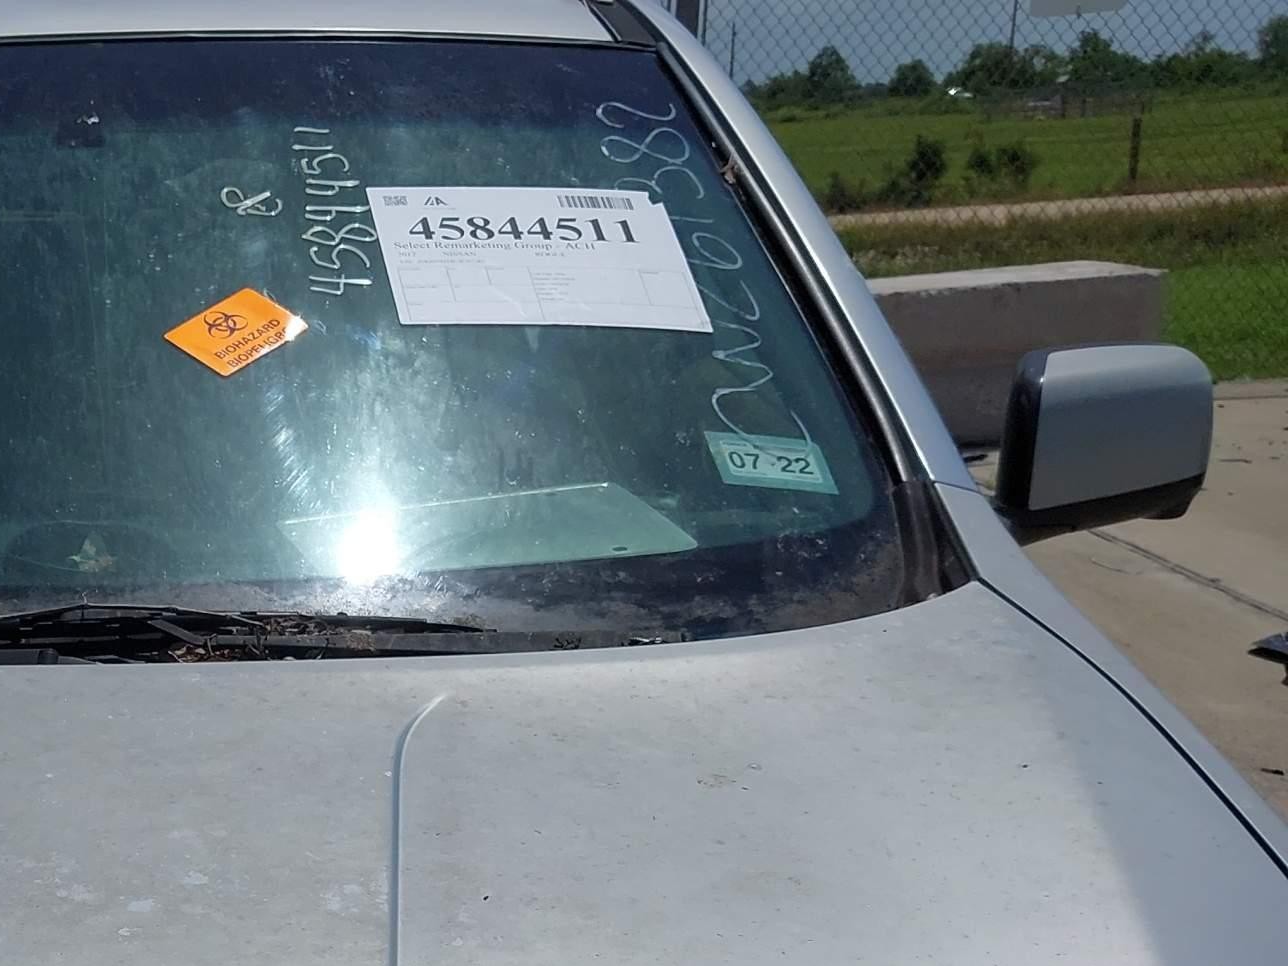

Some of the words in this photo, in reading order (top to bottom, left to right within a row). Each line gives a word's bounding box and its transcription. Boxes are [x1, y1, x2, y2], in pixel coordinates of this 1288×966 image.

[292, 127, 377, 296] 45844511
[409, 216, 640, 243] 45844511
[393, 241, 430, 249] Select
[435, 242, 511, 250] Remarketing
[514, 242, 552, 250] Group
[214, 319, 280, 360] BIOHAZARD
[728, 451, 759, 469] 07
[776, 456, 814, 474] 22
